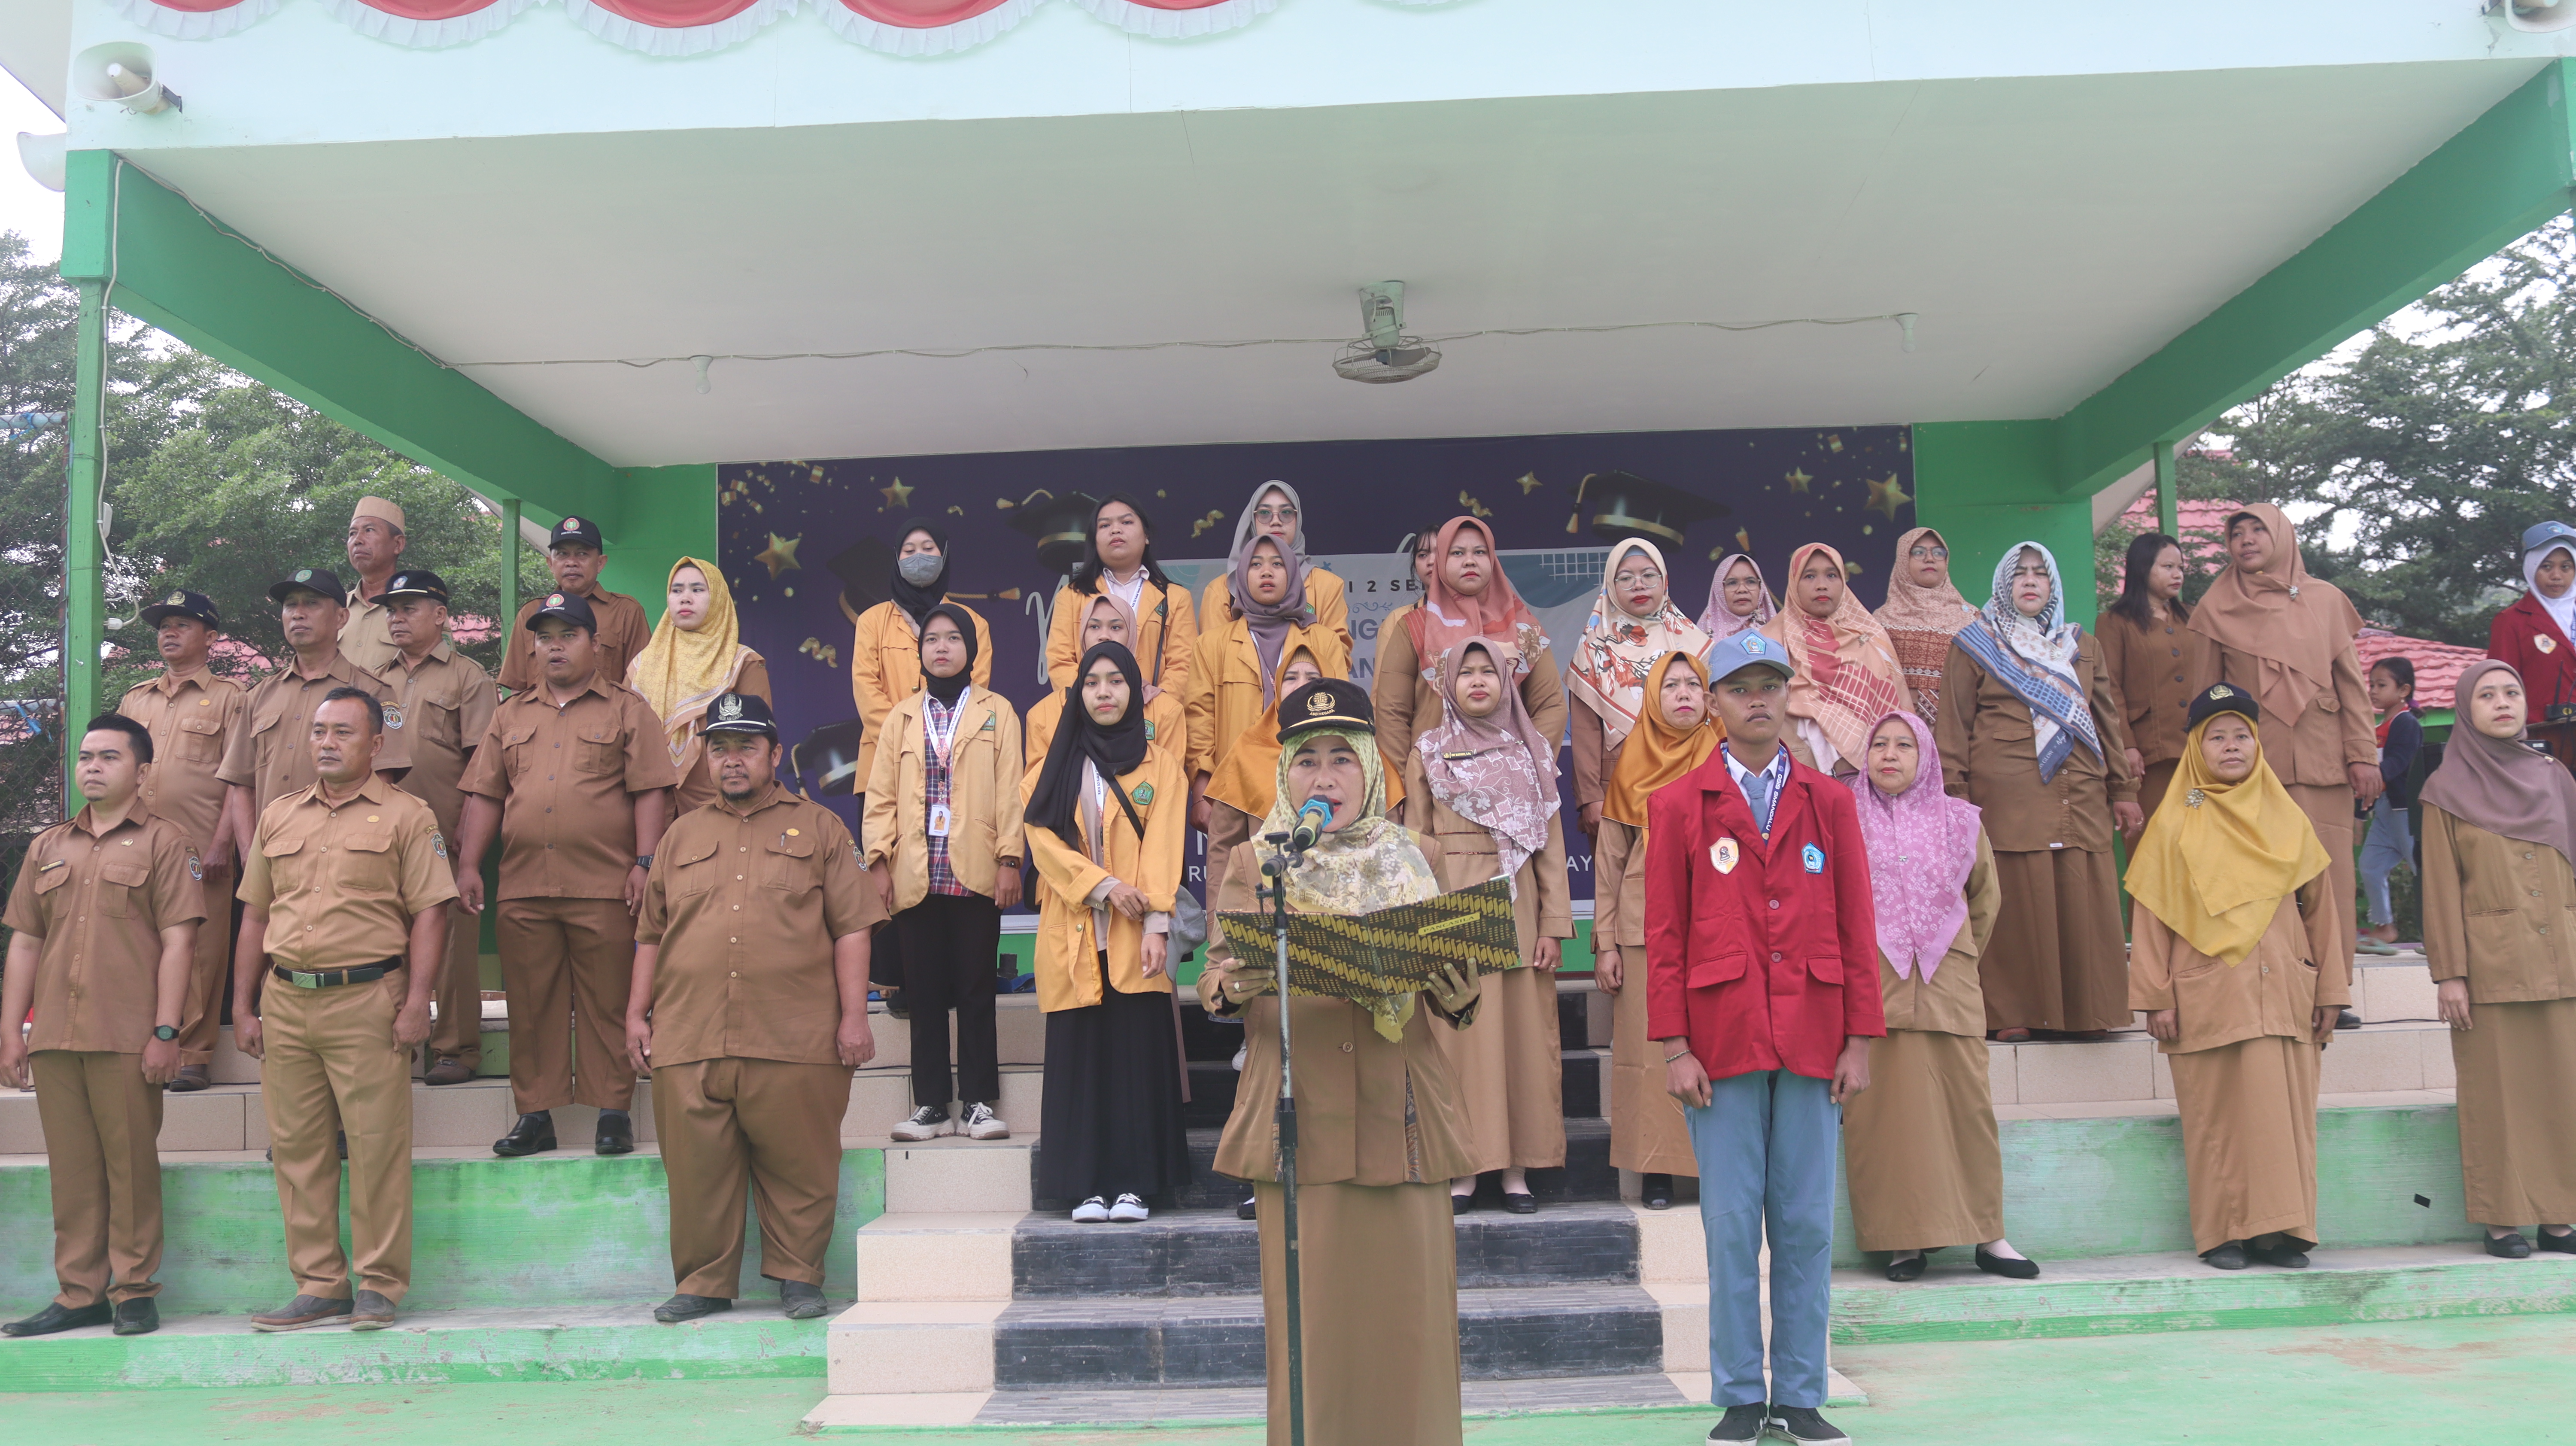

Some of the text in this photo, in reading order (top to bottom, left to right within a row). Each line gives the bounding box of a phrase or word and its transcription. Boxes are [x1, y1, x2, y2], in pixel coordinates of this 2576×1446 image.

[1367, 580, 1376, 592] 2
[1390, 579, 1425, 591] SE
[2042, 750, 2054, 764] GLOW
[1766, 791, 1778, 831] SMANDALU
[1423, 916, 1474, 932] PANCASILA
